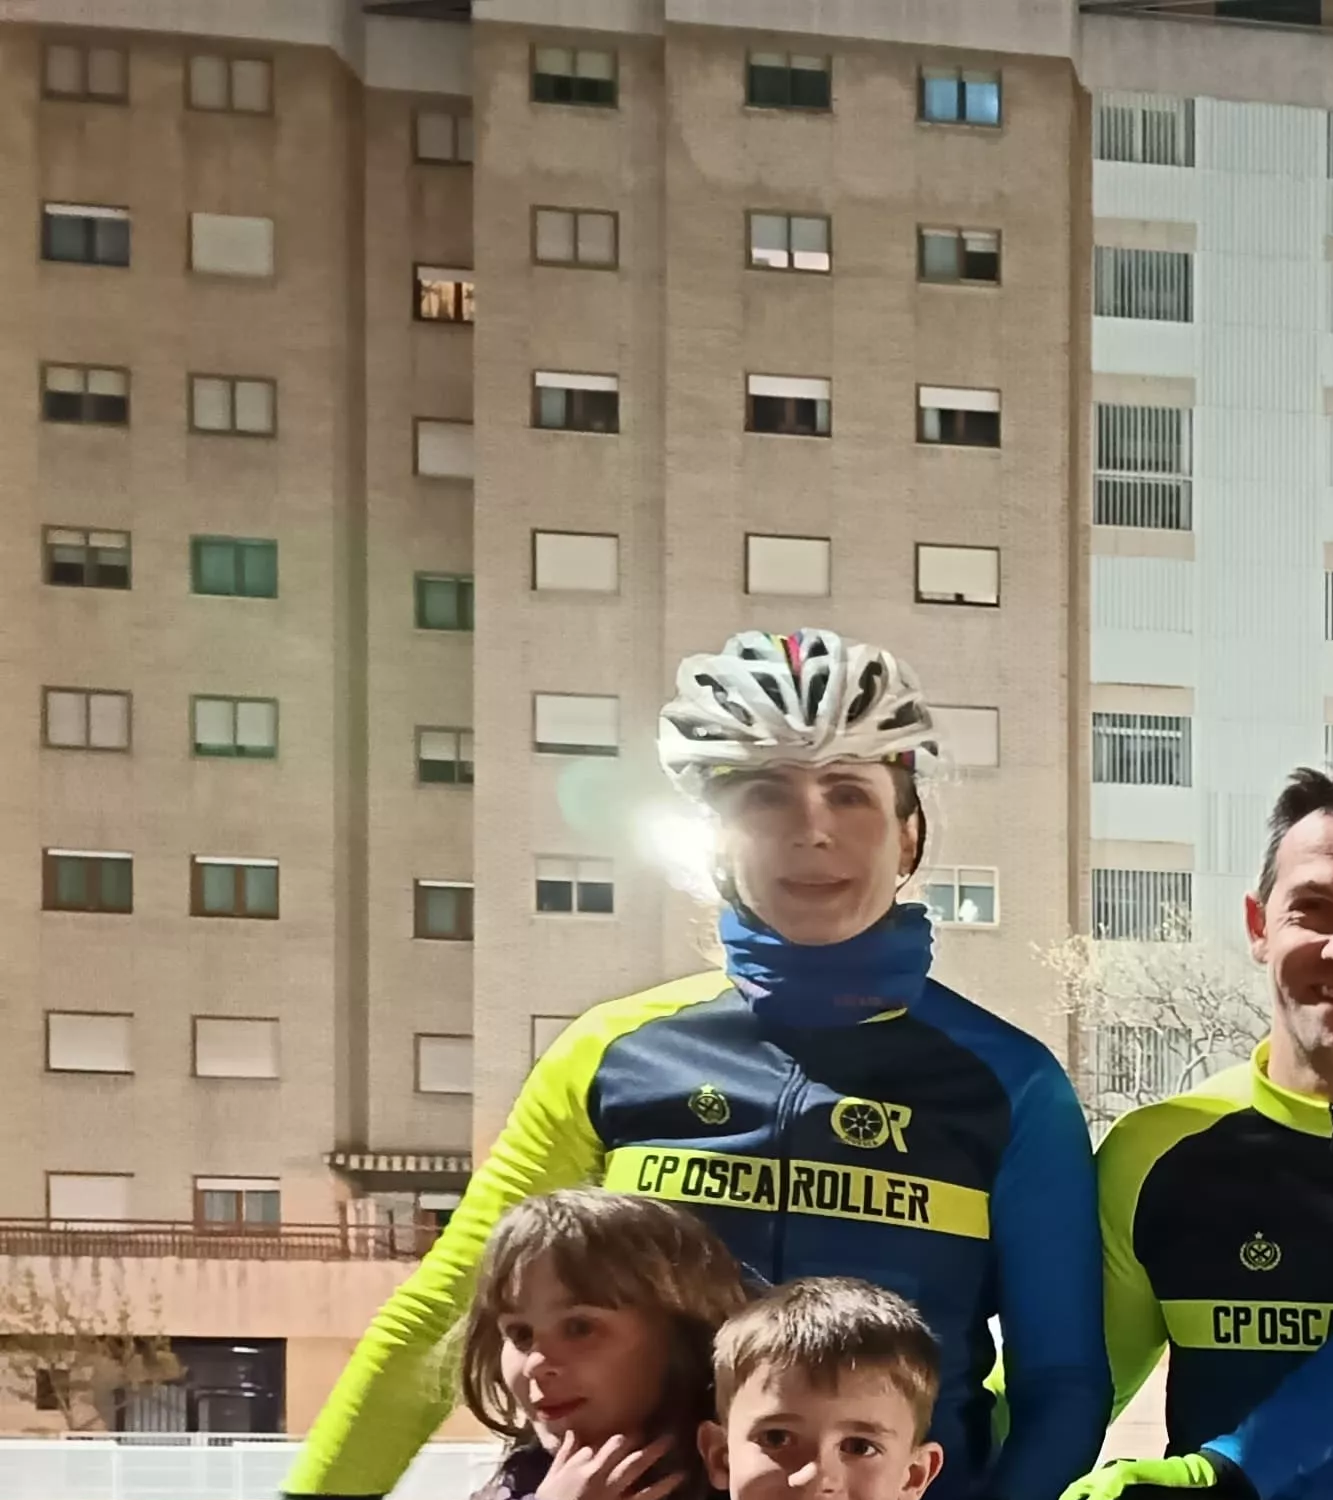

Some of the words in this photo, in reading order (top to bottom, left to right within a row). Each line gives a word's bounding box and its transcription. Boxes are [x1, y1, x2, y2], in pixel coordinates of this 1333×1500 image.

[638, 1154, 680, 1193] CP
[681, 1157, 775, 1206] OSCA
[792, 1167, 929, 1223] ROLLER
[1213, 1306, 1252, 1345] CP
